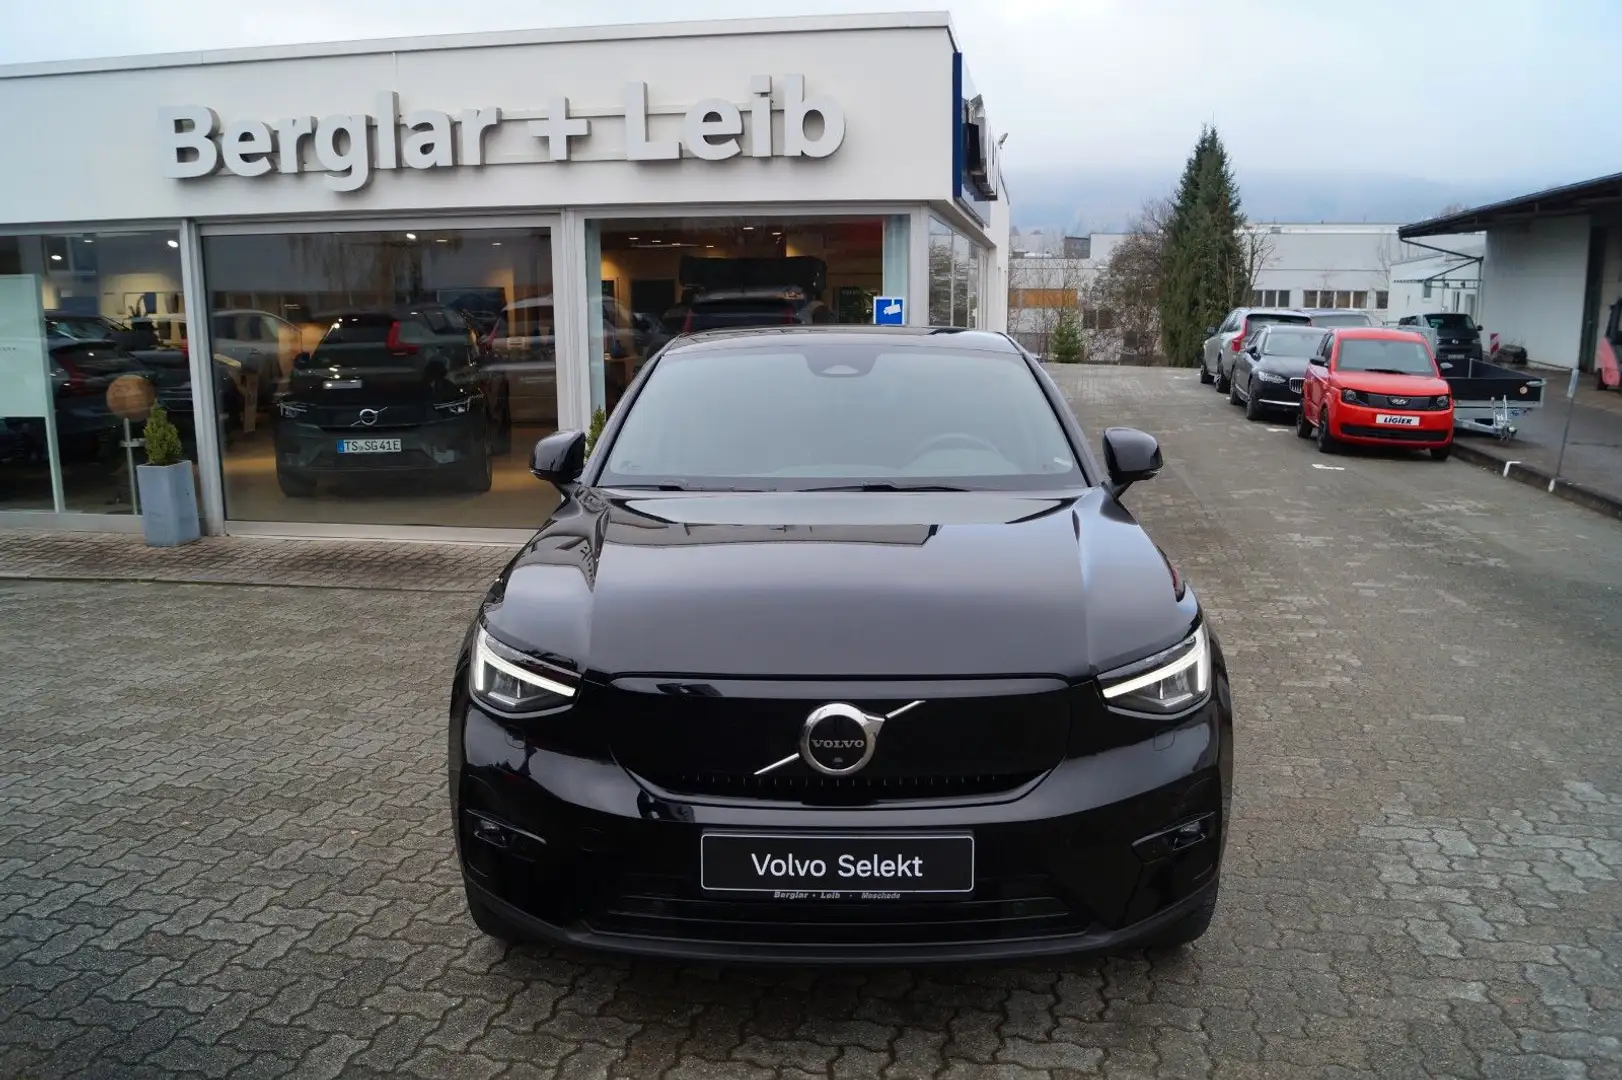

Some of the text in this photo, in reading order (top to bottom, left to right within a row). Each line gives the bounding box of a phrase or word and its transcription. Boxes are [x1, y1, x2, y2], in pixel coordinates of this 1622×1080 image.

[158, 73, 846, 194] Berglar + Leib
[811, 739, 865, 748] VOLVO
[751, 853, 923, 877] Volvo Selekt
